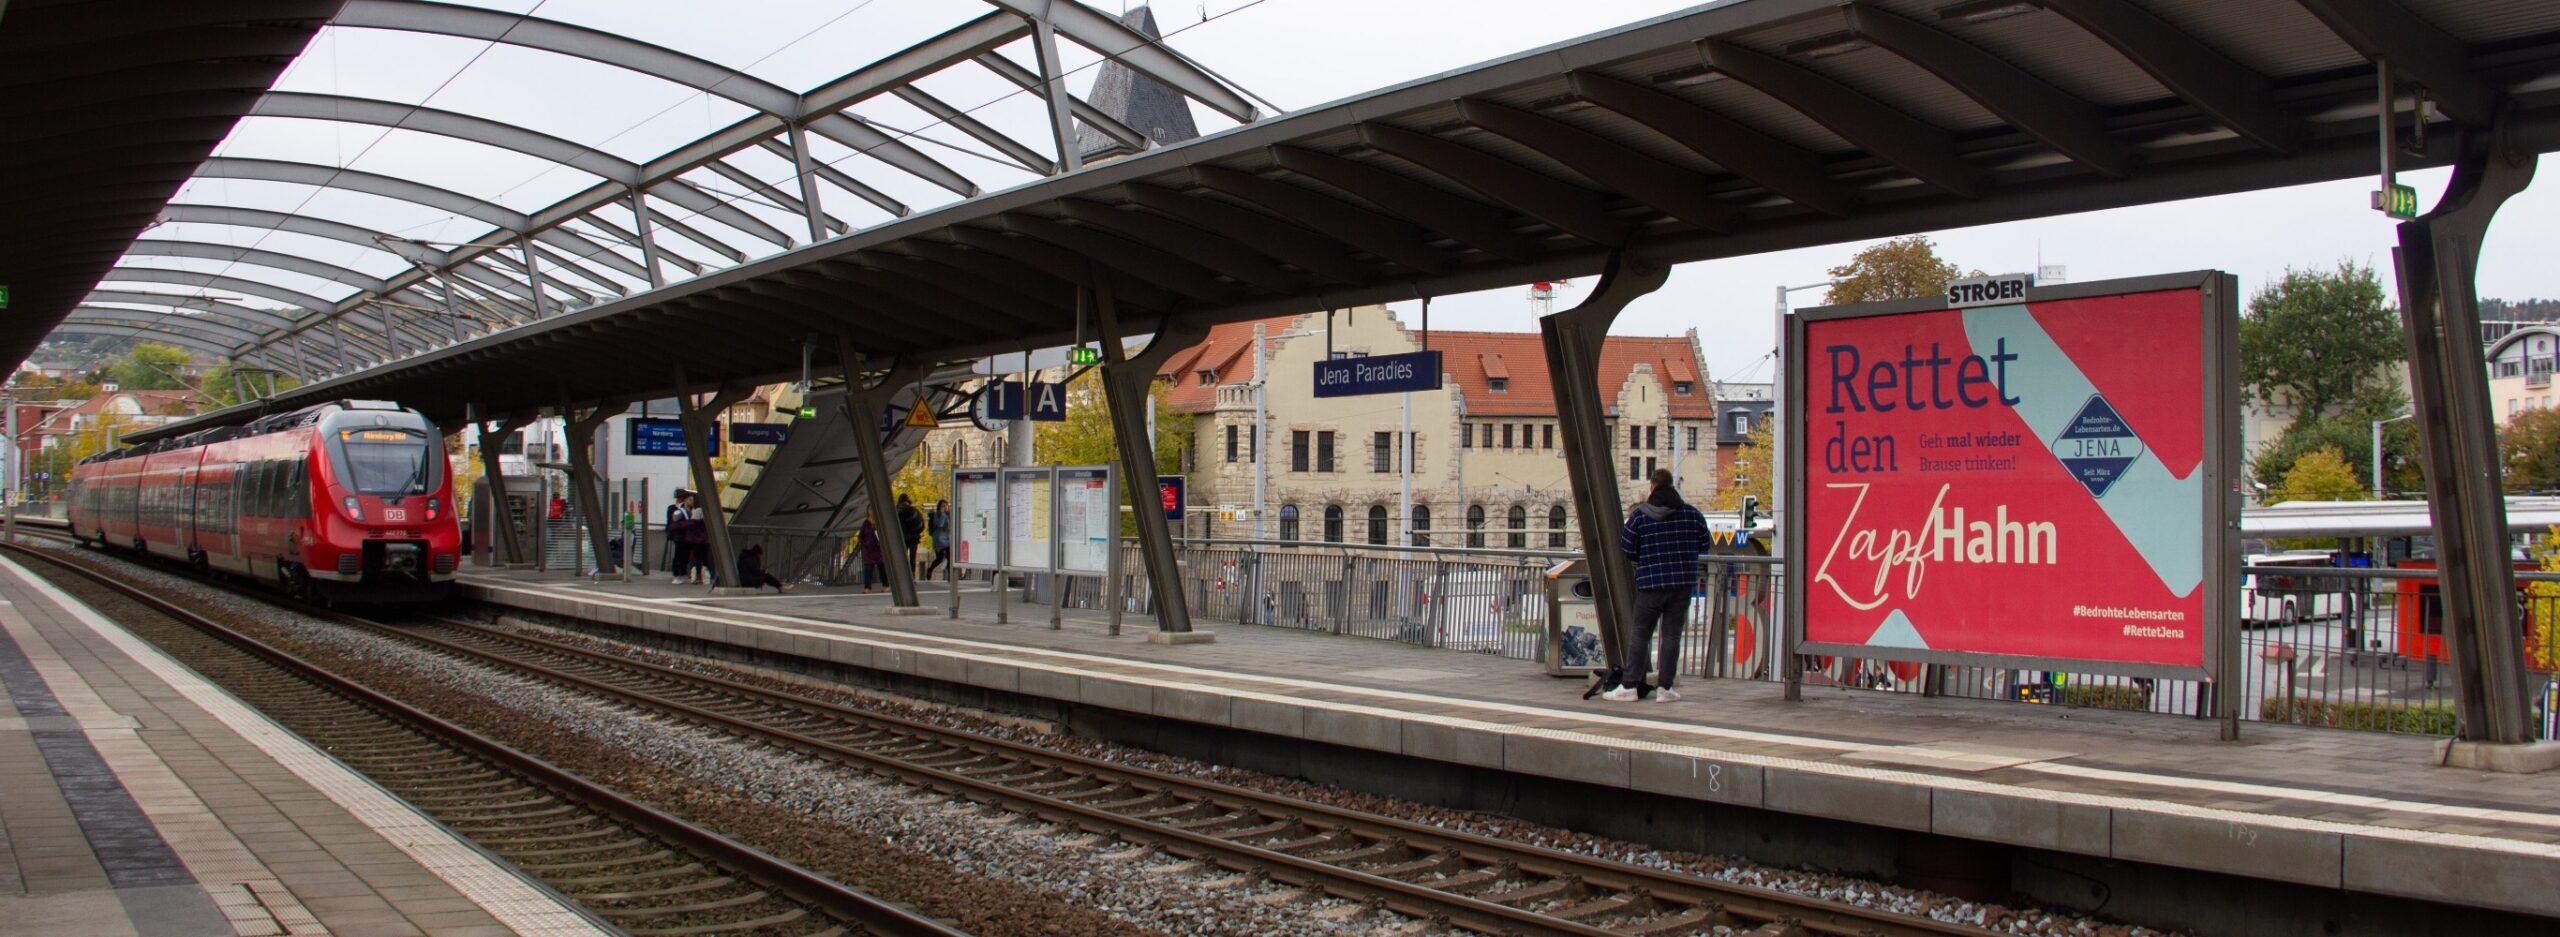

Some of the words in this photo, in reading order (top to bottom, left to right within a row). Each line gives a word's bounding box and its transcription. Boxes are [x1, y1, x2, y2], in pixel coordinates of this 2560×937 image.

[1949, 279, 2024, 304] STRÖER
[1320, 366, 1350, 386] Jena
[1356, 360, 1413, 383] Paradies
[1826, 337, 2021, 413] Rettet
[993, 382, 1005, 411] 1
[1036, 384, 1059, 413] A
[2074, 425, 2121, 433] Lebensarten.de
[2082, 416, 2113, 424] Bedrohte-
[1826, 421, 1898, 474] den
[1919, 433, 1944, 449] Geh
[1946, 432, 1972, 447] mal
[1975, 431, 2022, 447] wieder
[2074, 439, 2121, 458] JENA
[1919, 457, 1962, 472] Brause
[1965, 455, 2016, 471] trinken!
[386, 510, 405, 520] DB
[1814, 483, 2057, 611] ZapfHahn
[2073, 605, 2185, 621] #BedrohteLebensarten
[2123, 625, 2185, 638] #RettetJena
